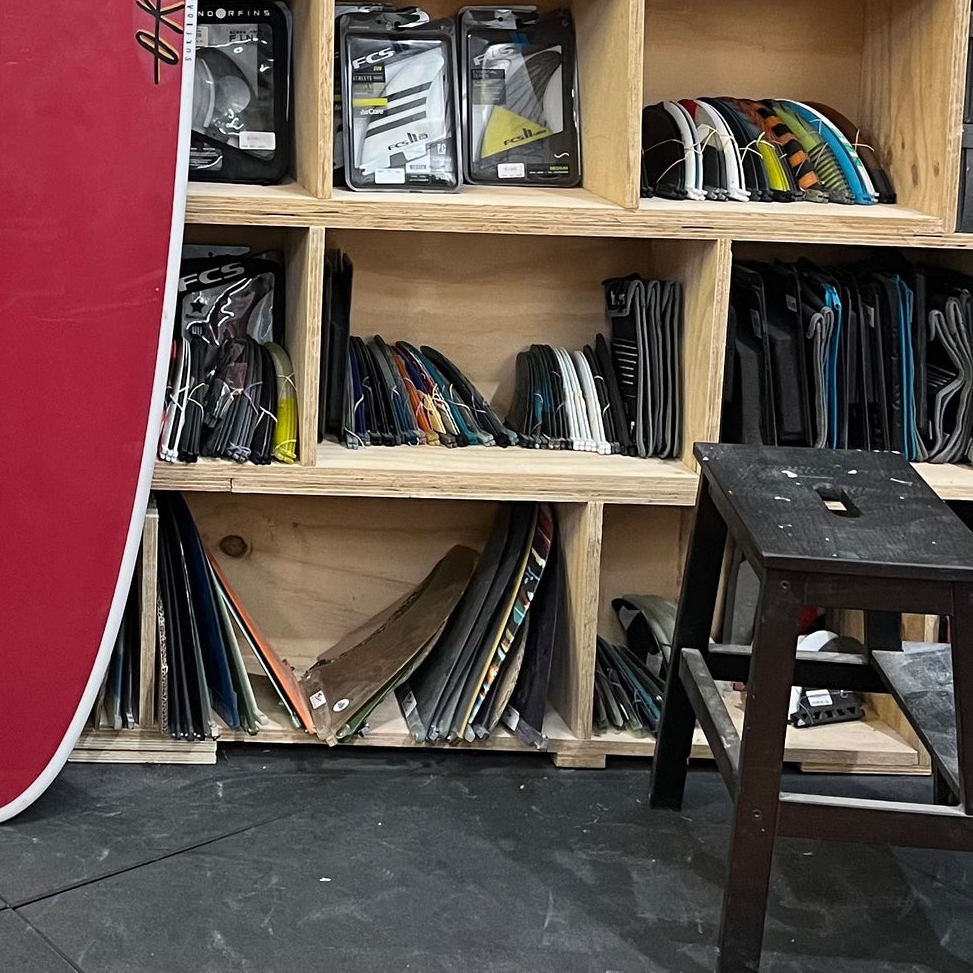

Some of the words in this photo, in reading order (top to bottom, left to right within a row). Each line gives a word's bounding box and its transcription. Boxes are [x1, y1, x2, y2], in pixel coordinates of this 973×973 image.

[352, 47, 396, 70] FCS
[473, 44, 515, 67] FS
[178, 262, 246, 293] FCS
